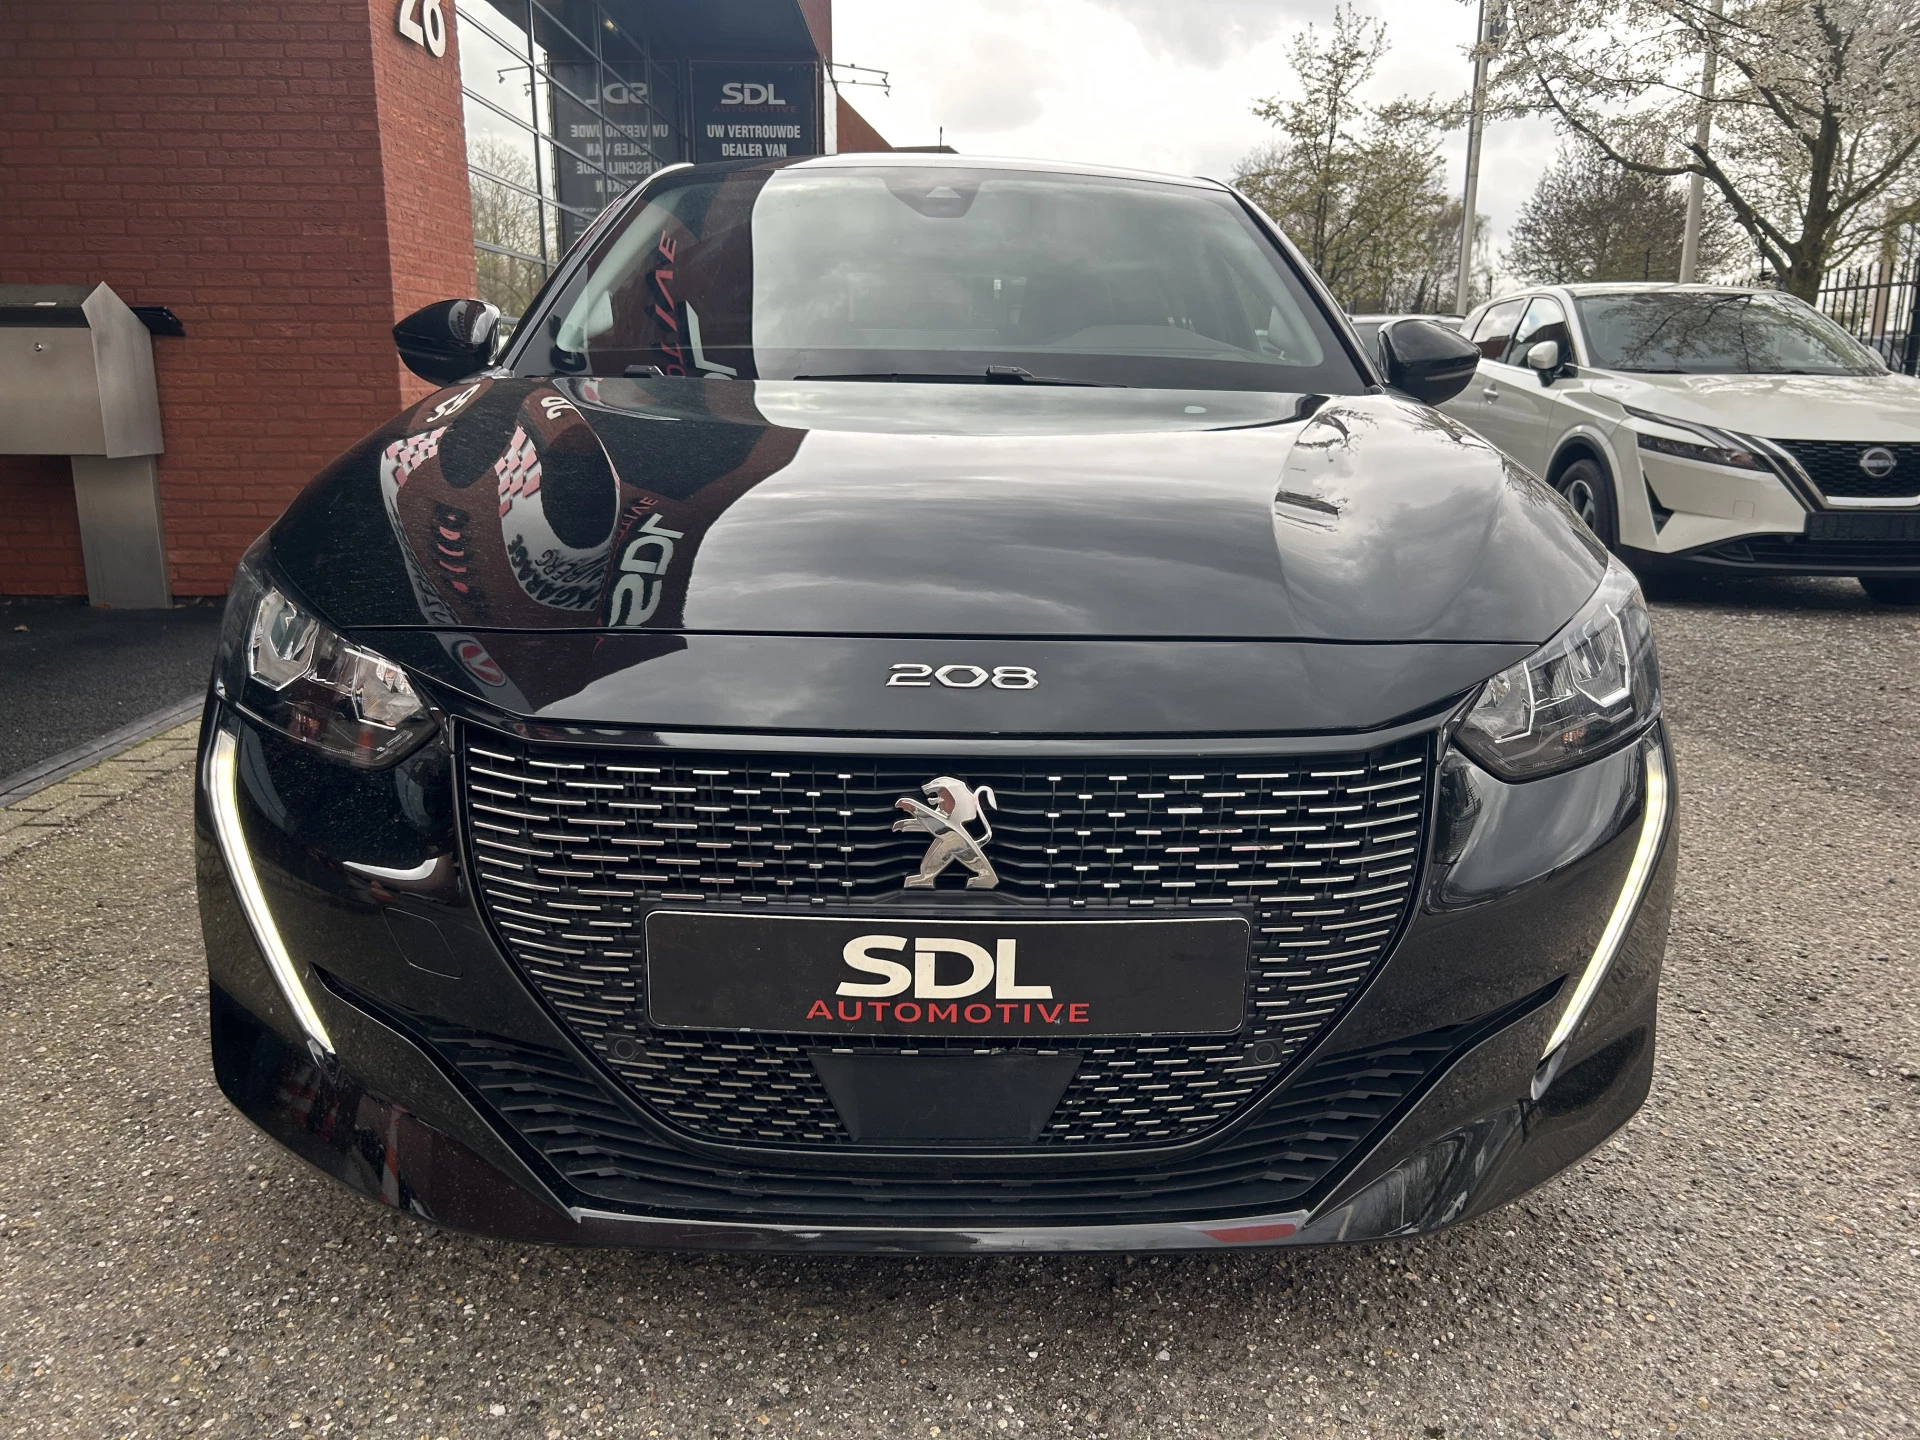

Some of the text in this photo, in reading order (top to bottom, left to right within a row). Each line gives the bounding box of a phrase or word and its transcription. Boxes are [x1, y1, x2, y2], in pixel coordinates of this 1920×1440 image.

[720, 83, 787, 105] SDL
[712, 105, 797, 113] AUTOMOTIVE
[707, 124, 801, 139] UW VERTROUWDE
[722, 143, 787, 157] DEALER VAN
[885, 663, 1039, 690] 208
[835, 934, 1053, 1000] SDL
[806, 1000, 1090, 1023] AUTOMOTIVE
